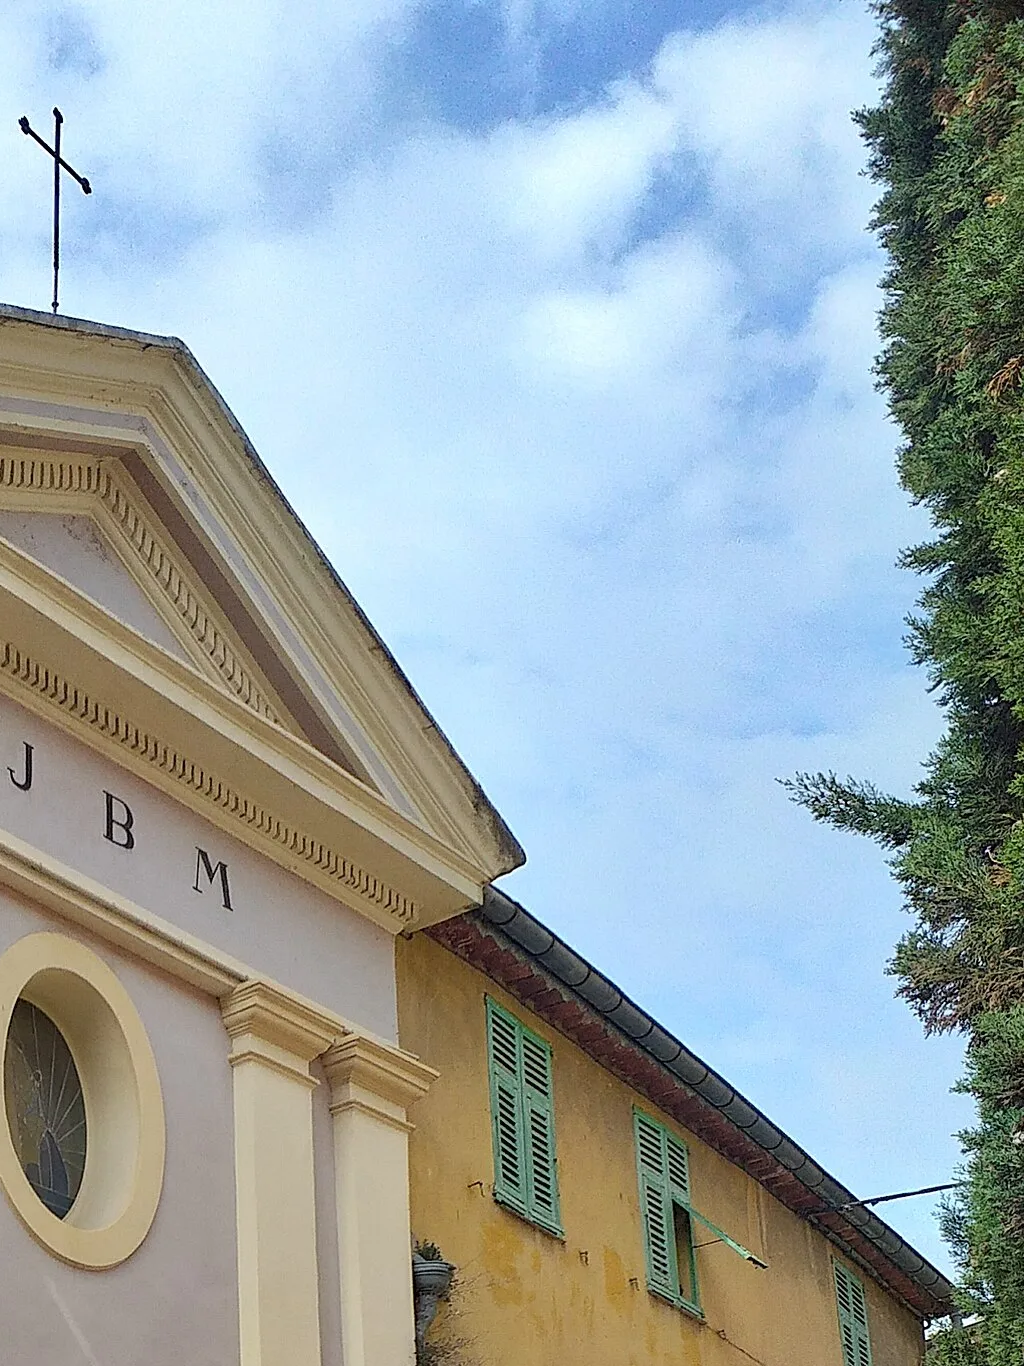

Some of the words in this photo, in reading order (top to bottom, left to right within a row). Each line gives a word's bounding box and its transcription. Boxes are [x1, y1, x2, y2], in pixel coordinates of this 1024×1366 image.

[7, 741, 34, 791] J
[103, 790, 134, 849] B
[192, 846, 233, 911] M
